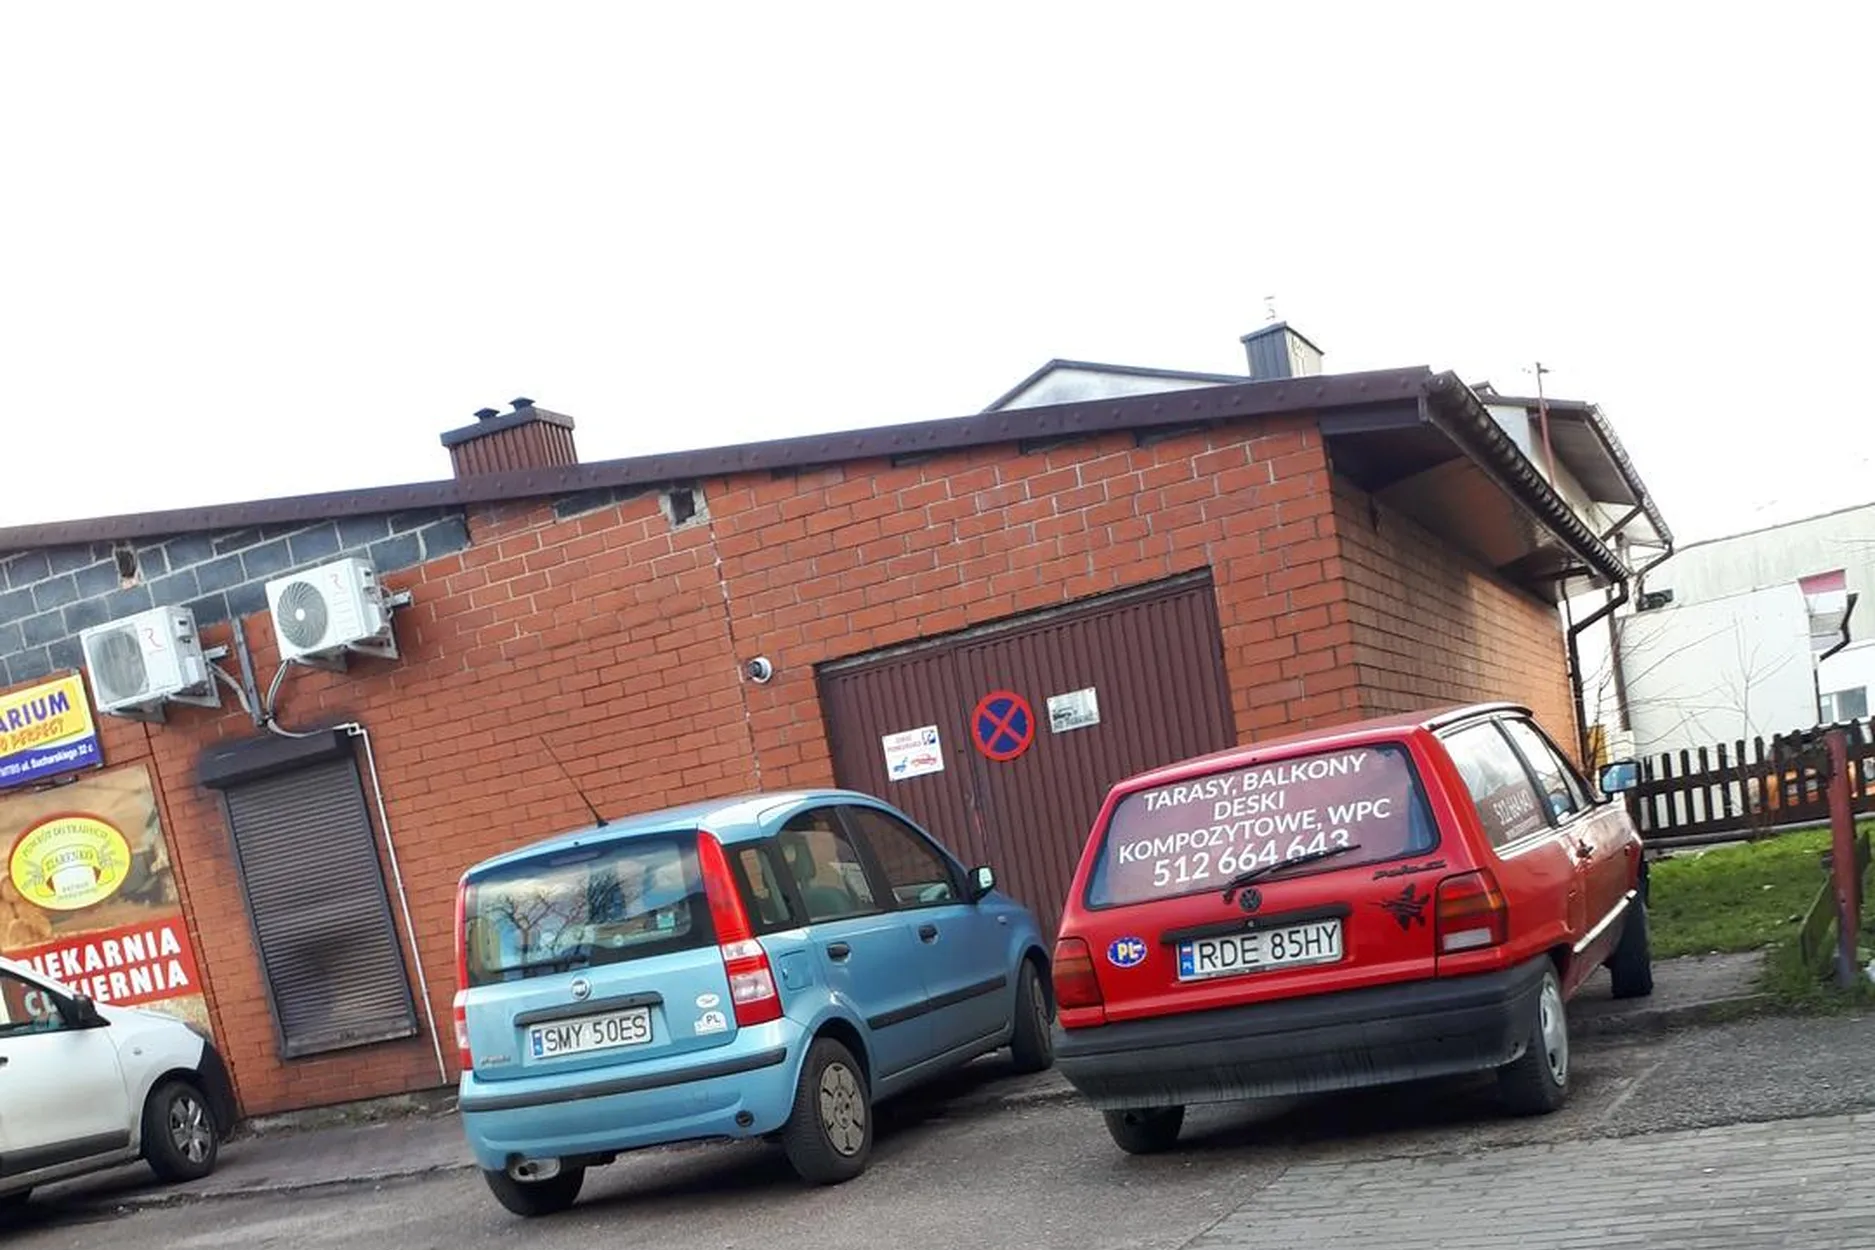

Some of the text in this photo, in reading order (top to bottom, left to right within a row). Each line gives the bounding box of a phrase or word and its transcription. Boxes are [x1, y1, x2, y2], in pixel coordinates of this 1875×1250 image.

[1144, 753, 1368, 813] TARASY, BALKONY
[1214, 790, 1286, 821] DESKI
[1118, 798, 1392, 864] KOMPOZYTOWE, WPC
[1153, 851, 1210, 888] 512
[1218, 840, 1280, 875] 664
[1117, 942, 1140, 961] PL
[1199, 923, 1340, 972] RDE 85HY
[545, 1015, 647, 1052] SMY 50ES
[705, 1014, 722, 1026] PL
